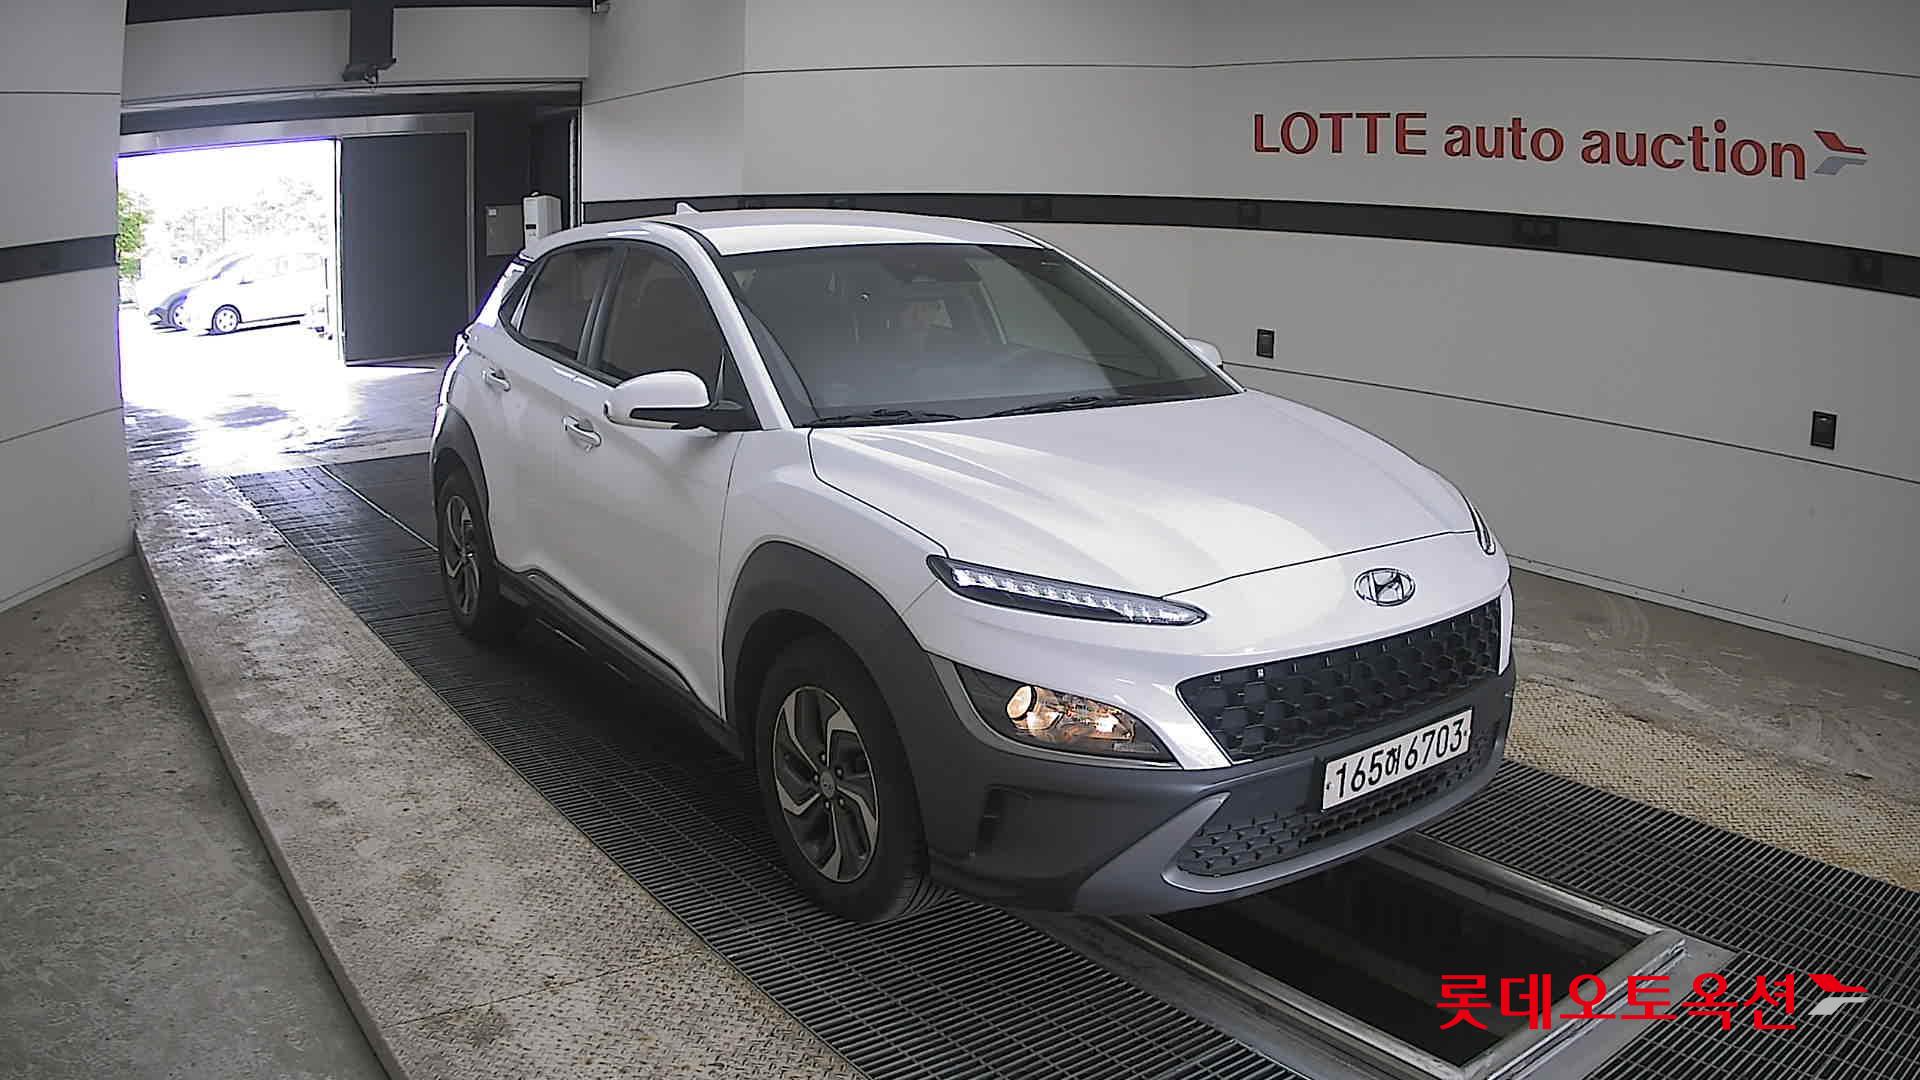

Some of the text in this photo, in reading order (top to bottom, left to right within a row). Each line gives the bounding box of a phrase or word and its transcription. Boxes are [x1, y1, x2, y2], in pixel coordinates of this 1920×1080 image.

[1255, 112, 1806, 180] LOTTE auto auction
